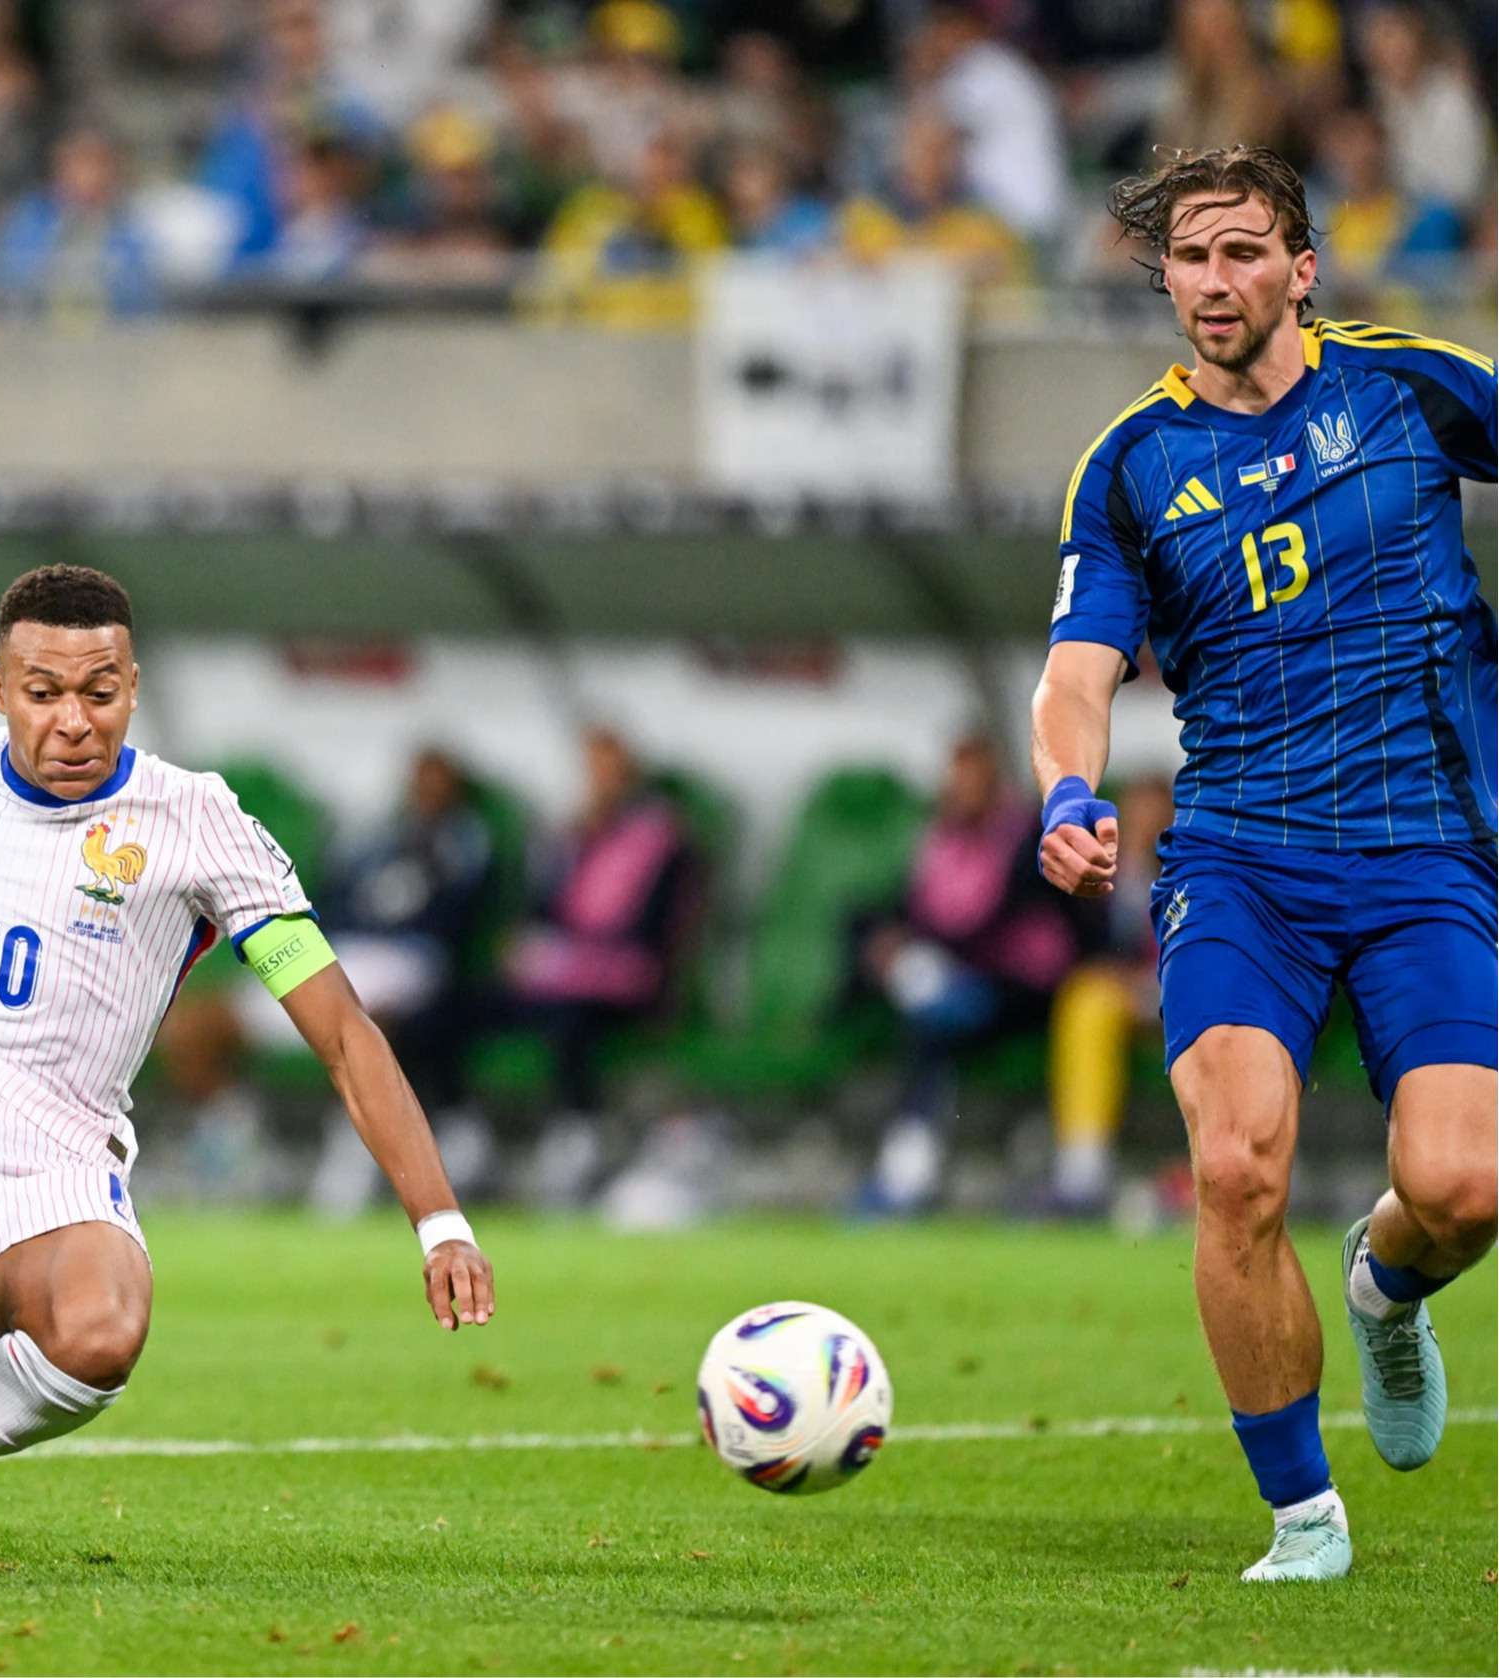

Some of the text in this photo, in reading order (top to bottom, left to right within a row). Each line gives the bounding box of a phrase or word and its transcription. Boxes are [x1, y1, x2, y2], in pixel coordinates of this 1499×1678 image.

[1241, 521, 1310, 613] 13
[73, 920, 95, 930] UKRAINE
[100, 925, 119, 936] FRANCE
[257, 937, 305, 977] RESPECT
